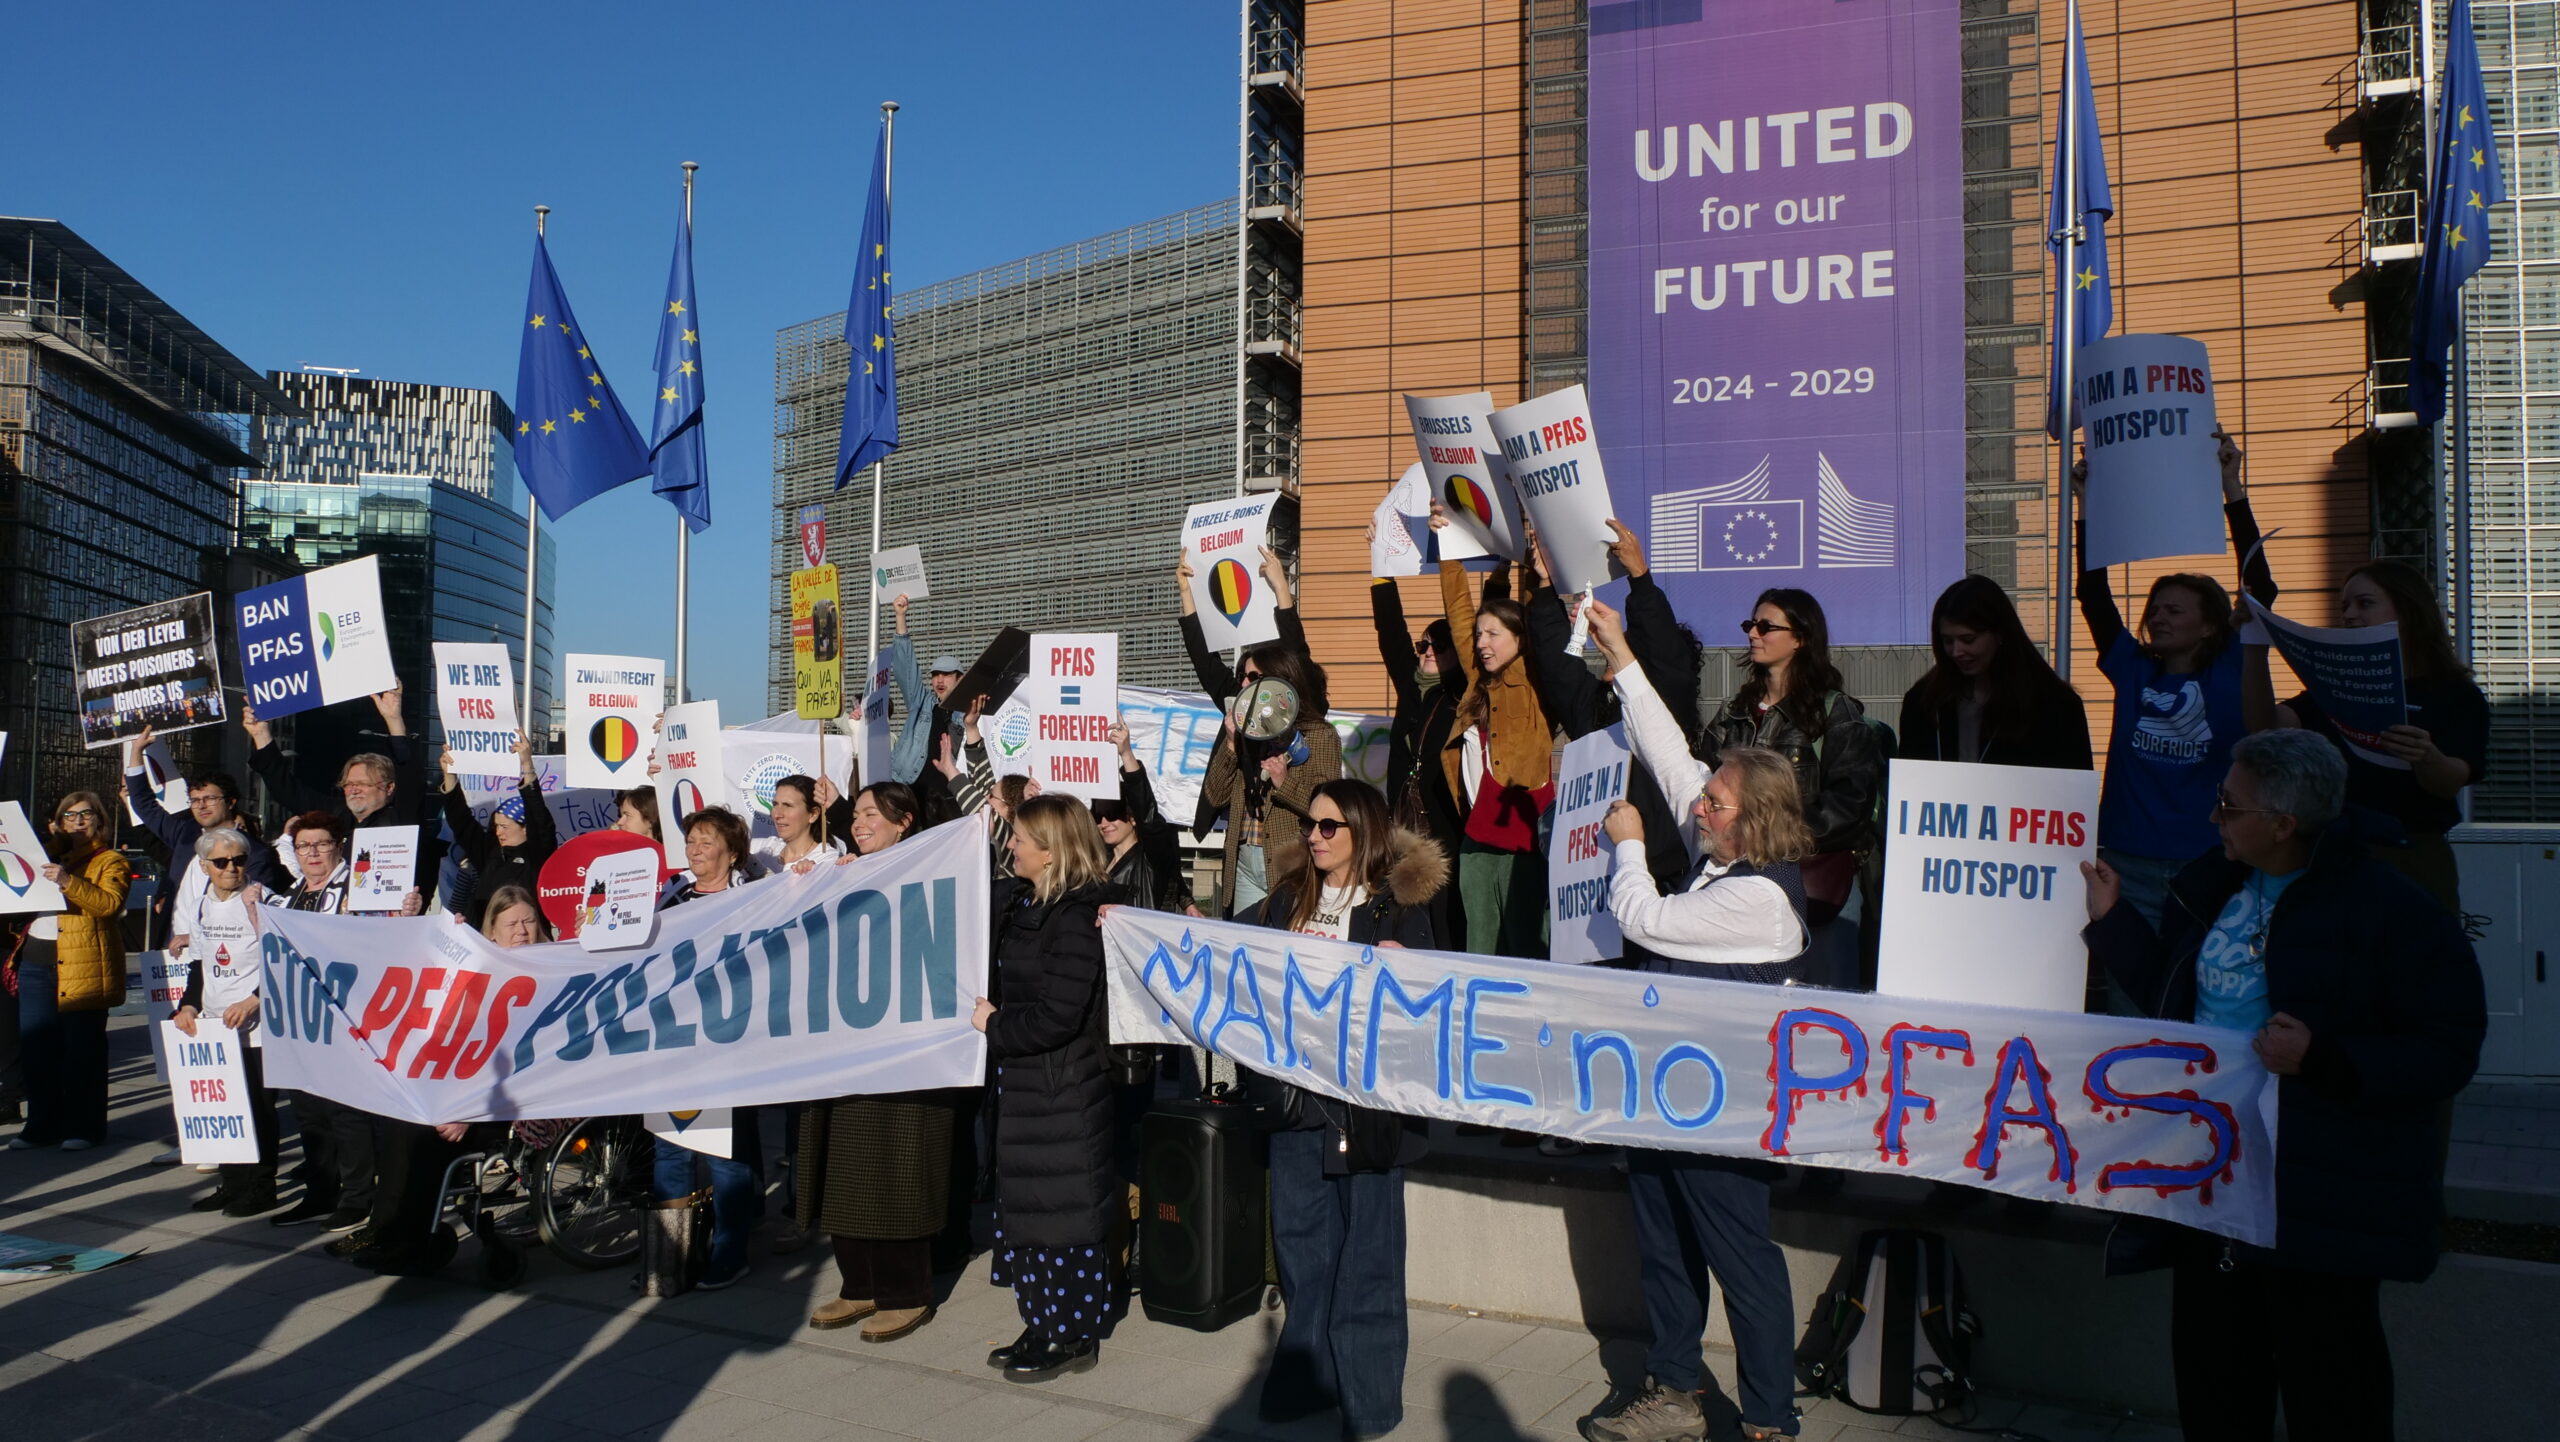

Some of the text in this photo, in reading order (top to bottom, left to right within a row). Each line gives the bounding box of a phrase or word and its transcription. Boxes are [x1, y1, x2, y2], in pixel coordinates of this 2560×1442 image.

[1635, 101, 1913, 182] UNITED
[1700, 193, 1845, 233] for our
[1654, 250, 1894, 314] FUTURE
[1672, 374, 1753, 404] 2024
[1790, 366, 1875, 398] 2029
[2087, 370, 2115, 407] AM
[2122, 366, 2139, 396] A
[2146, 363, 2206, 395] PFAS
[1418, 415, 1472, 436] BRUSSELS
[1505, 434, 1529, 463] AM
[1529, 430, 1542, 456] A
[1542, 416, 1587, 452] PFAS
[2094, 407, 2190, 449] HOTSPOT
[1428, 446, 1477, 465] BELGIUM
[1520, 459, 1580, 499] HOTSPOT
[1190, 503, 1264, 530] HERZELE-RONSE
[1200, 527, 1244, 553] BELGIUM
[243, 595, 289, 628] BAN
[338, 611, 361, 628] EEB
[95, 620, 185, 658] VON DER LEYEN
[247, 632, 304, 666] PFAS
[86, 662, 127, 689] MEETS
[128, 648, 195, 680] POISONERS
[1050, 646, 1095, 677] PFAS
[2313, 649, 2366, 663] children
[2369, 651, 2392, 662] are
[2313, 662, 2392, 678] pre-polluted
[253, 670, 309, 705] NOW
[447, 663, 501, 687] WE ARE
[576, 669, 656, 687] ZWIJNDRECHT
[819, 668, 832, 689] VA
[2344, 679, 2395, 691] Forever
[113, 680, 184, 713] IGNORES US
[458, 698, 495, 720] PFAS
[588, 693, 638, 709] BELGIUM
[2331, 688, 2396, 704] Chemicals
[448, 729, 516, 753] HOTSPOTS
[667, 723, 687, 742] LYON
[1039, 714, 1109, 743] FOREVER
[667, 751, 697, 770] FRANCE
[743, 766, 757, 783] RETE
[757, 755, 774, 767] ZERO
[775, 754, 792, 764] PFAS
[1050, 756, 1100, 784] HARM
[1559, 761, 1623, 816] I LIVE IN A
[1899, 800, 2086, 848] I AM A PFAS
[1567, 821, 1600, 865] PFAS
[1922, 857, 2057, 901] HOTSPOT
[260, 876, 958, 1081] STOP PFAS POLLUTION
[179, 1042, 227, 1067] I AM A
[1142, 938, 2240, 1206] MAMME no PFAS
[190, 1078, 227, 1103] PFAS
[183, 1115, 246, 1140] HOTSPOT
[1158, 1202, 1182, 1224] JBL
